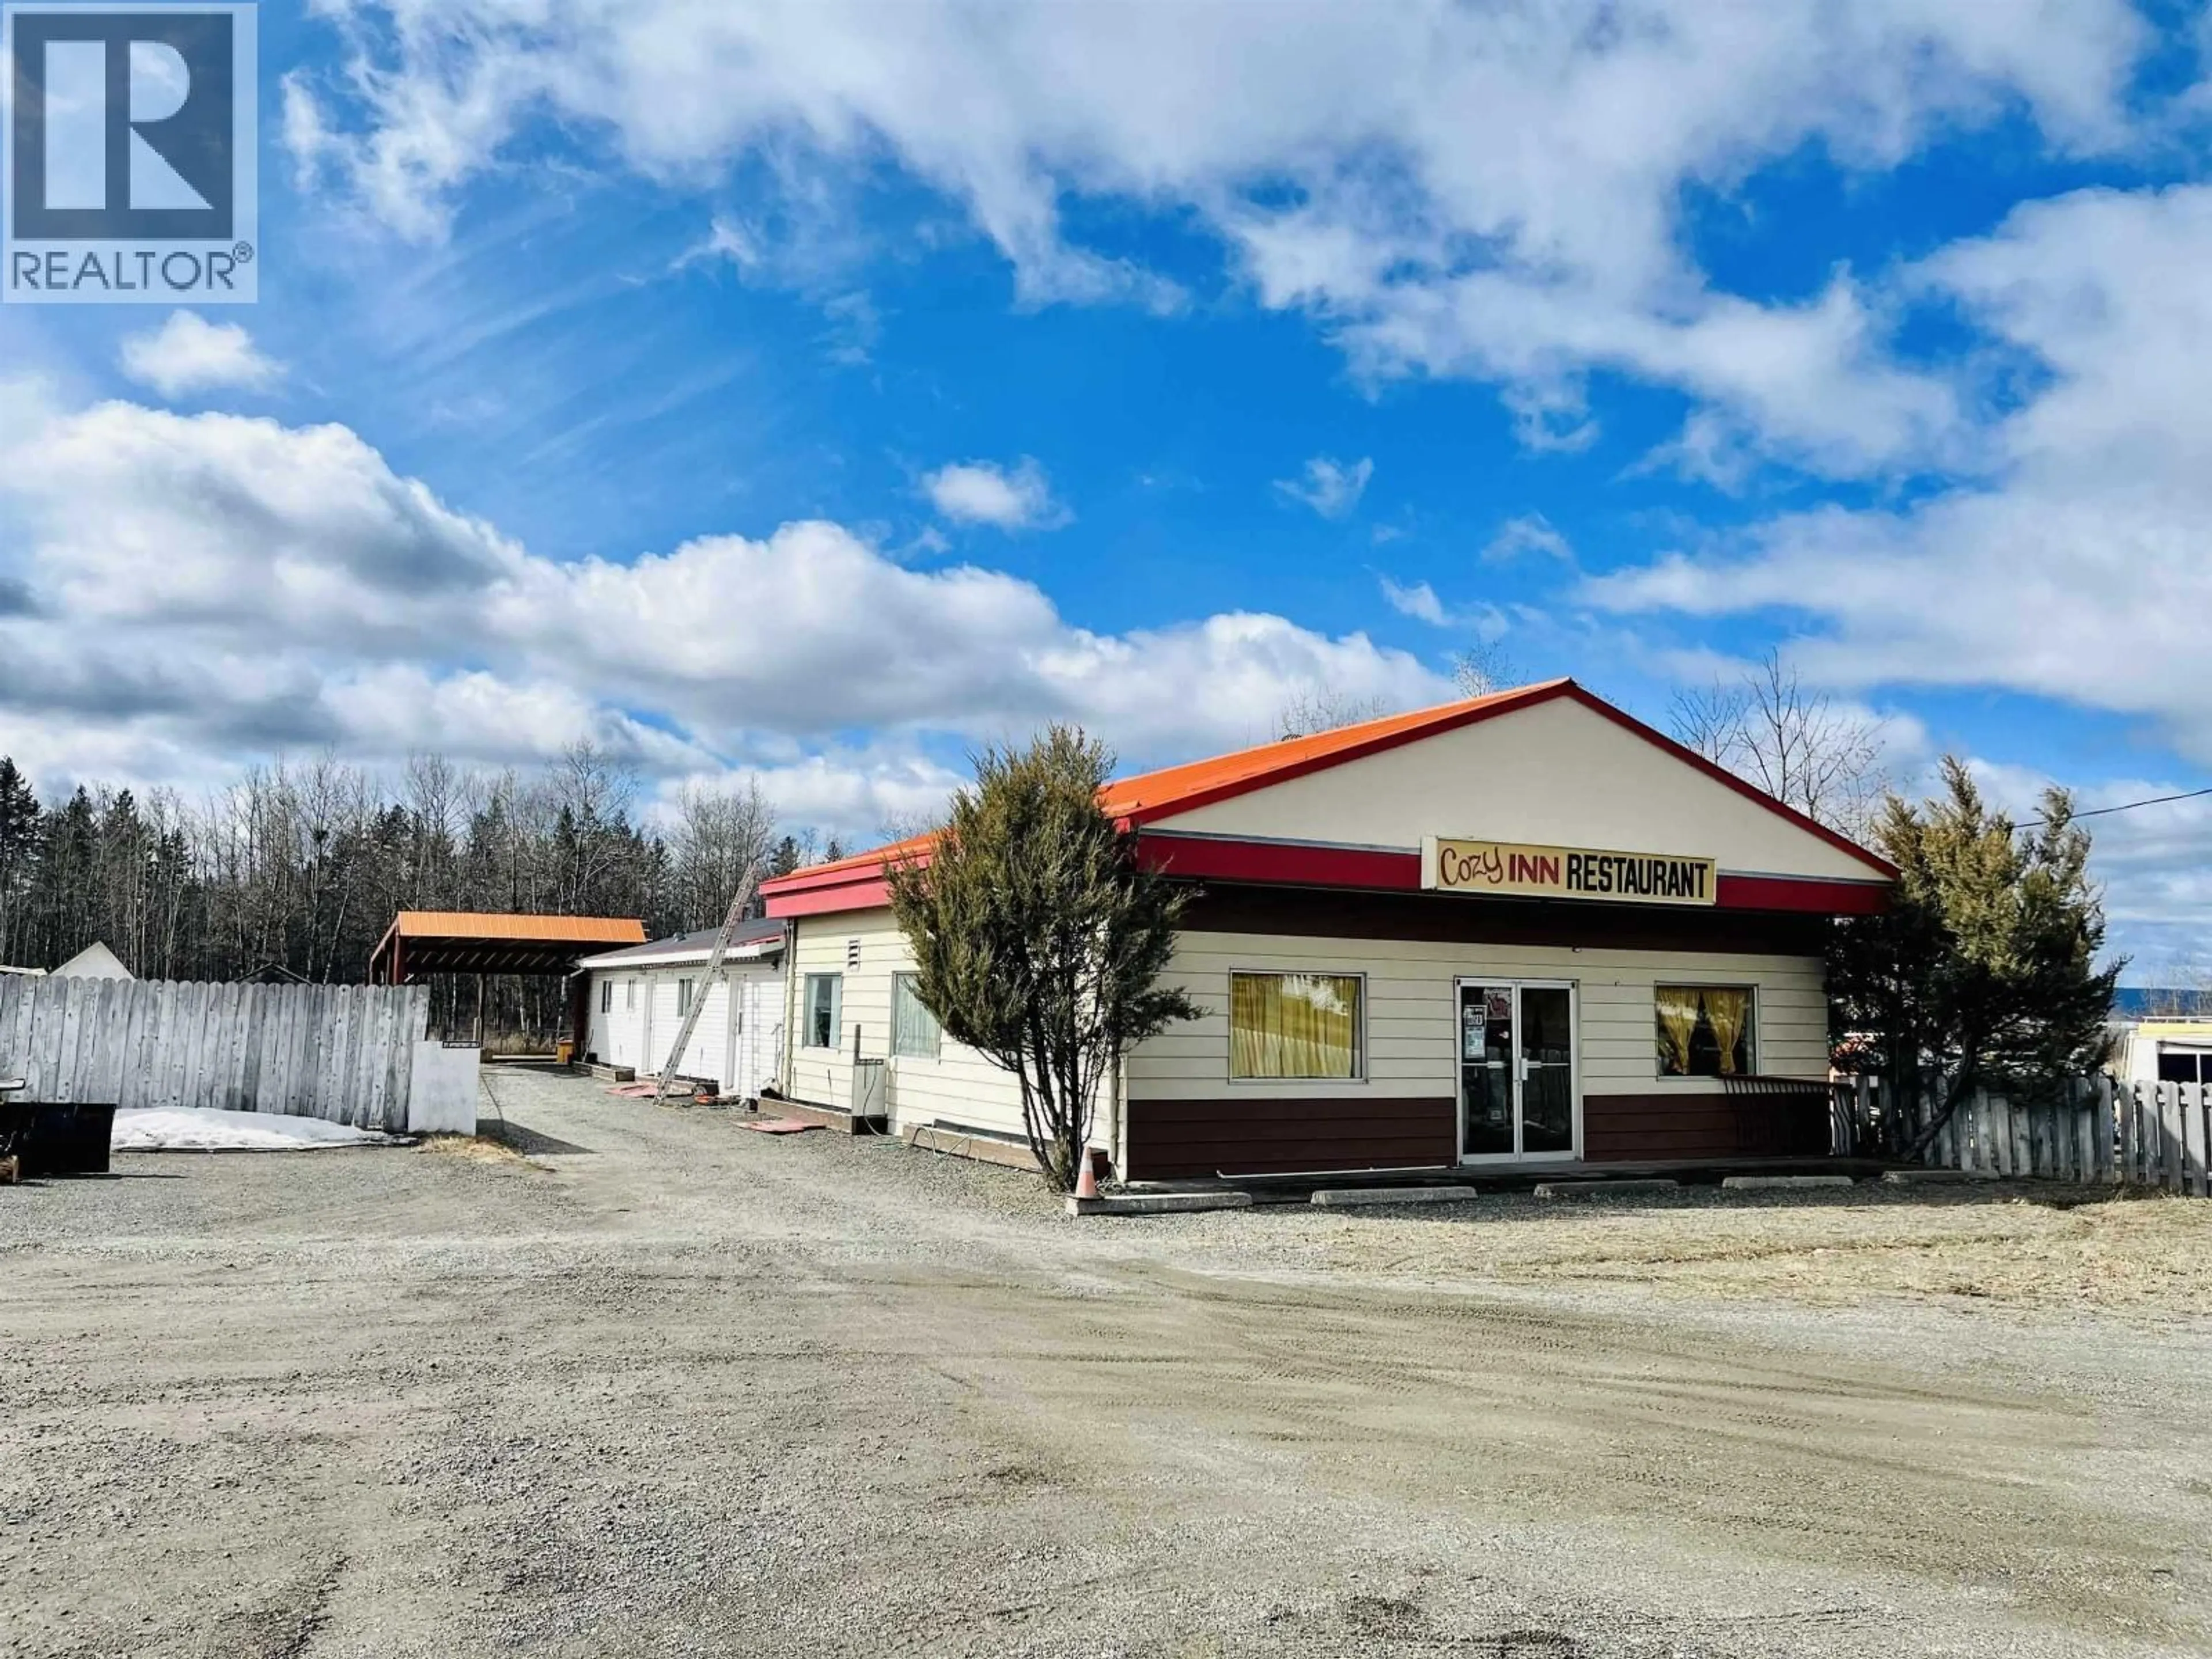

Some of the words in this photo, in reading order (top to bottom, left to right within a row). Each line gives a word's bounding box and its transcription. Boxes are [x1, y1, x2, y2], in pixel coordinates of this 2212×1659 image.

[1441, 846, 1503, 885] Cozy
[1508, 853, 1559, 884] INN
[1566, 853, 1709, 897] RESTAURANT
